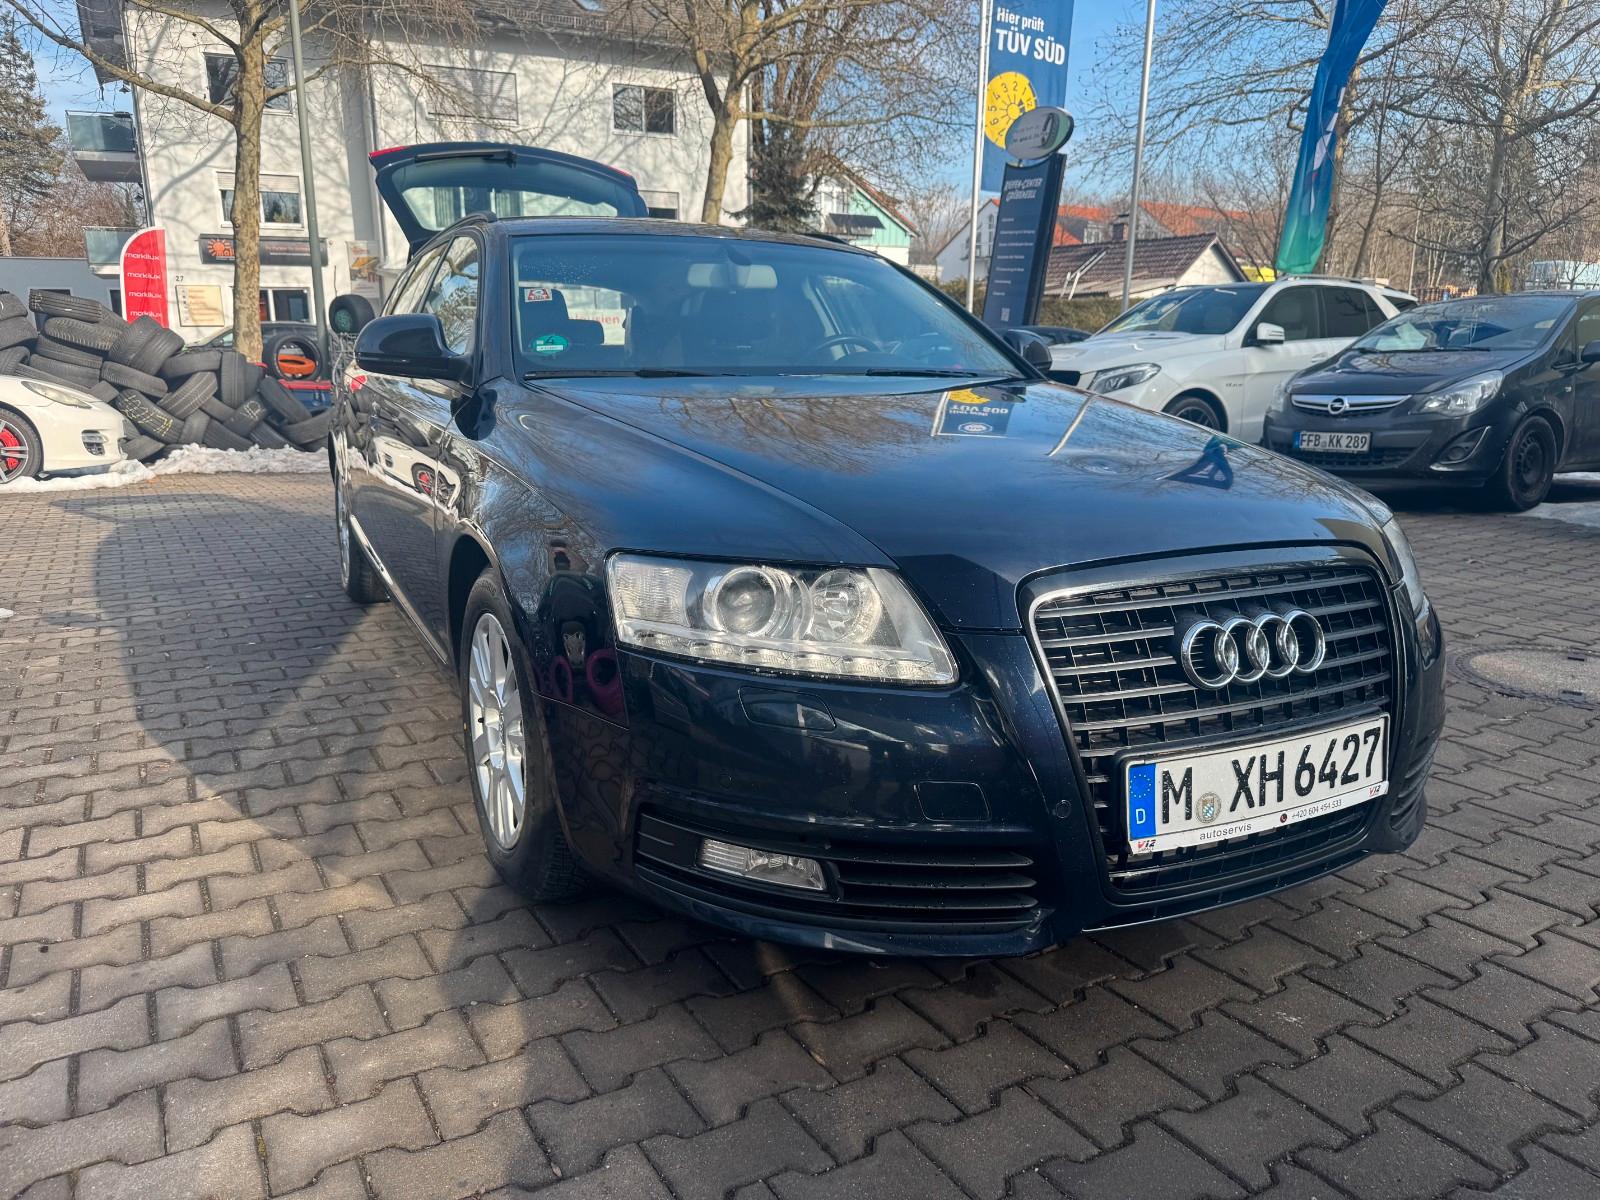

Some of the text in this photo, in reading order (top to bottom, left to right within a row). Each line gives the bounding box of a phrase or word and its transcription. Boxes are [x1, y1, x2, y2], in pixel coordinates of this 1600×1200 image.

[997, 7, 1045, 32] Hier prüft
[996, 26, 1065, 65] TÜV SÜD
[125, 252, 160, 260] markilux
[127, 271, 161, 279] markilux
[128, 290, 162, 299] markilux
[545, 336, 555, 345] 4
[1301, 433, 1367, 449] FFB KK 289
[1162, 727, 1381, 824] M XH 6427
[1331, 799, 1342, 809] 533
[1135, 808, 1146, 824] D
[1200, 822, 1252, 840] autoservis
